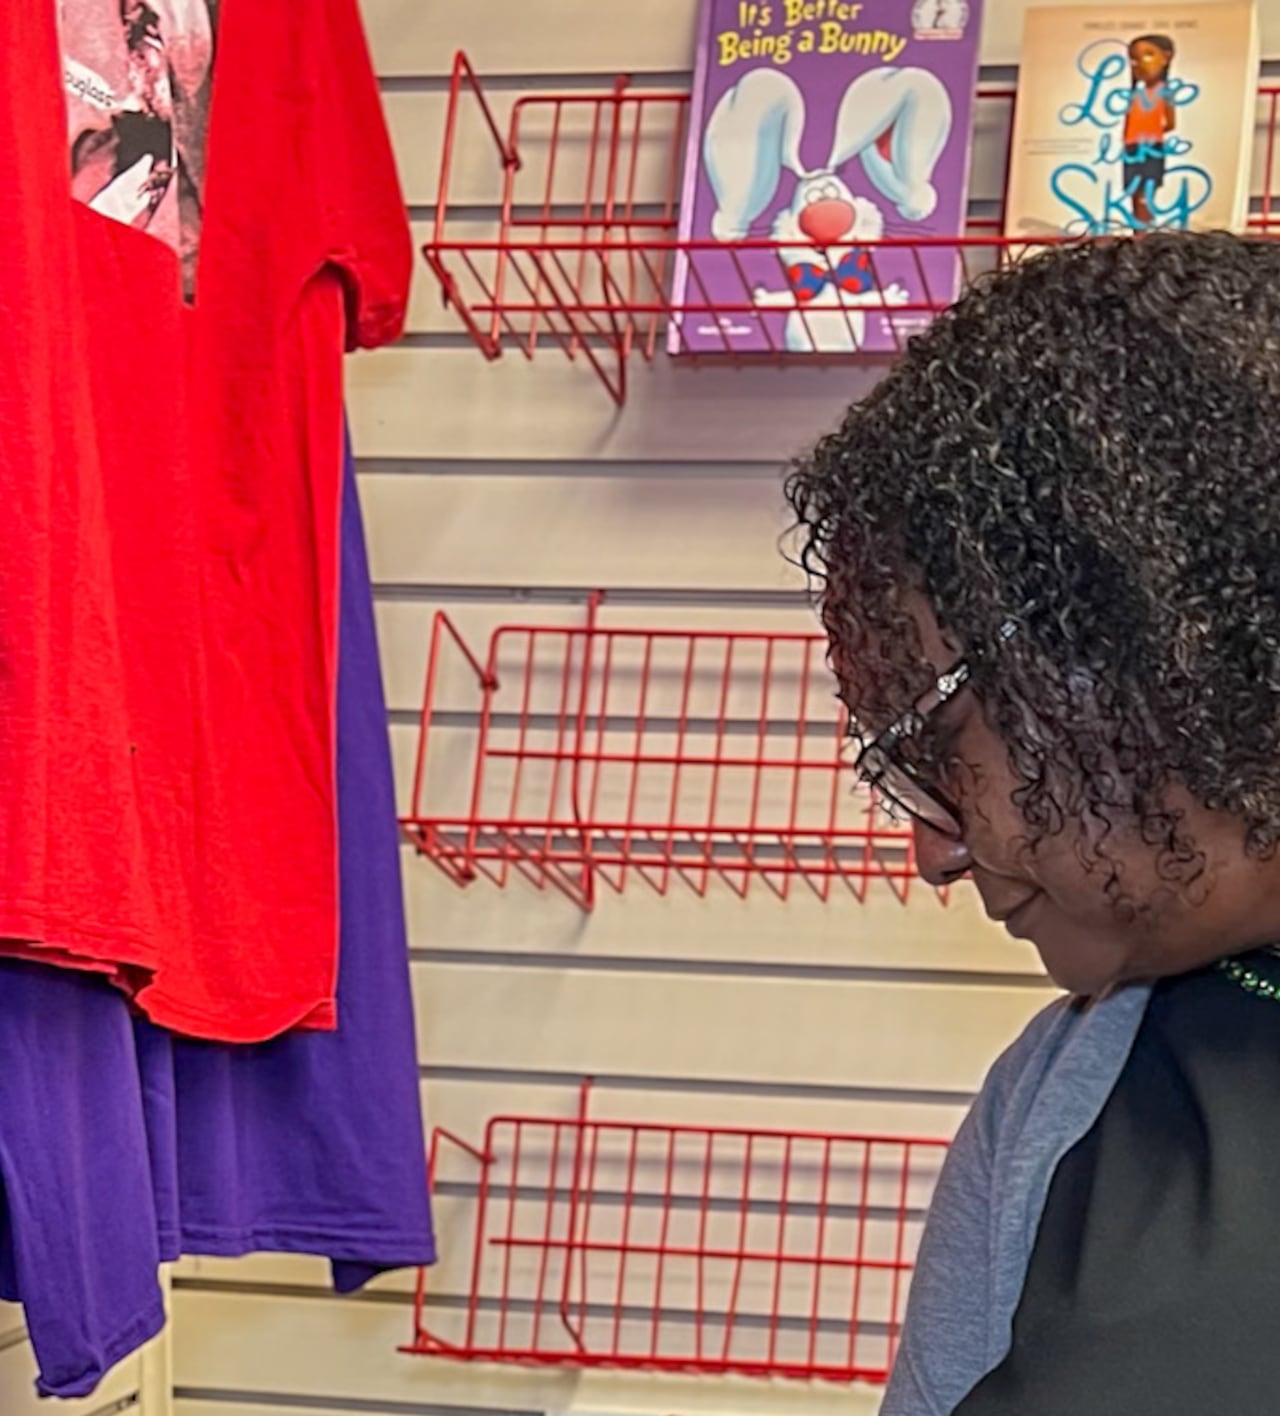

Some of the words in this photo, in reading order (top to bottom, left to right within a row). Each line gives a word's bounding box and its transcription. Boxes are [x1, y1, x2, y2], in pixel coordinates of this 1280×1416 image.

[718, 29, 793, 66] Being
[797, 30, 815, 53] a
[818, 21, 908, 62] Bunny
